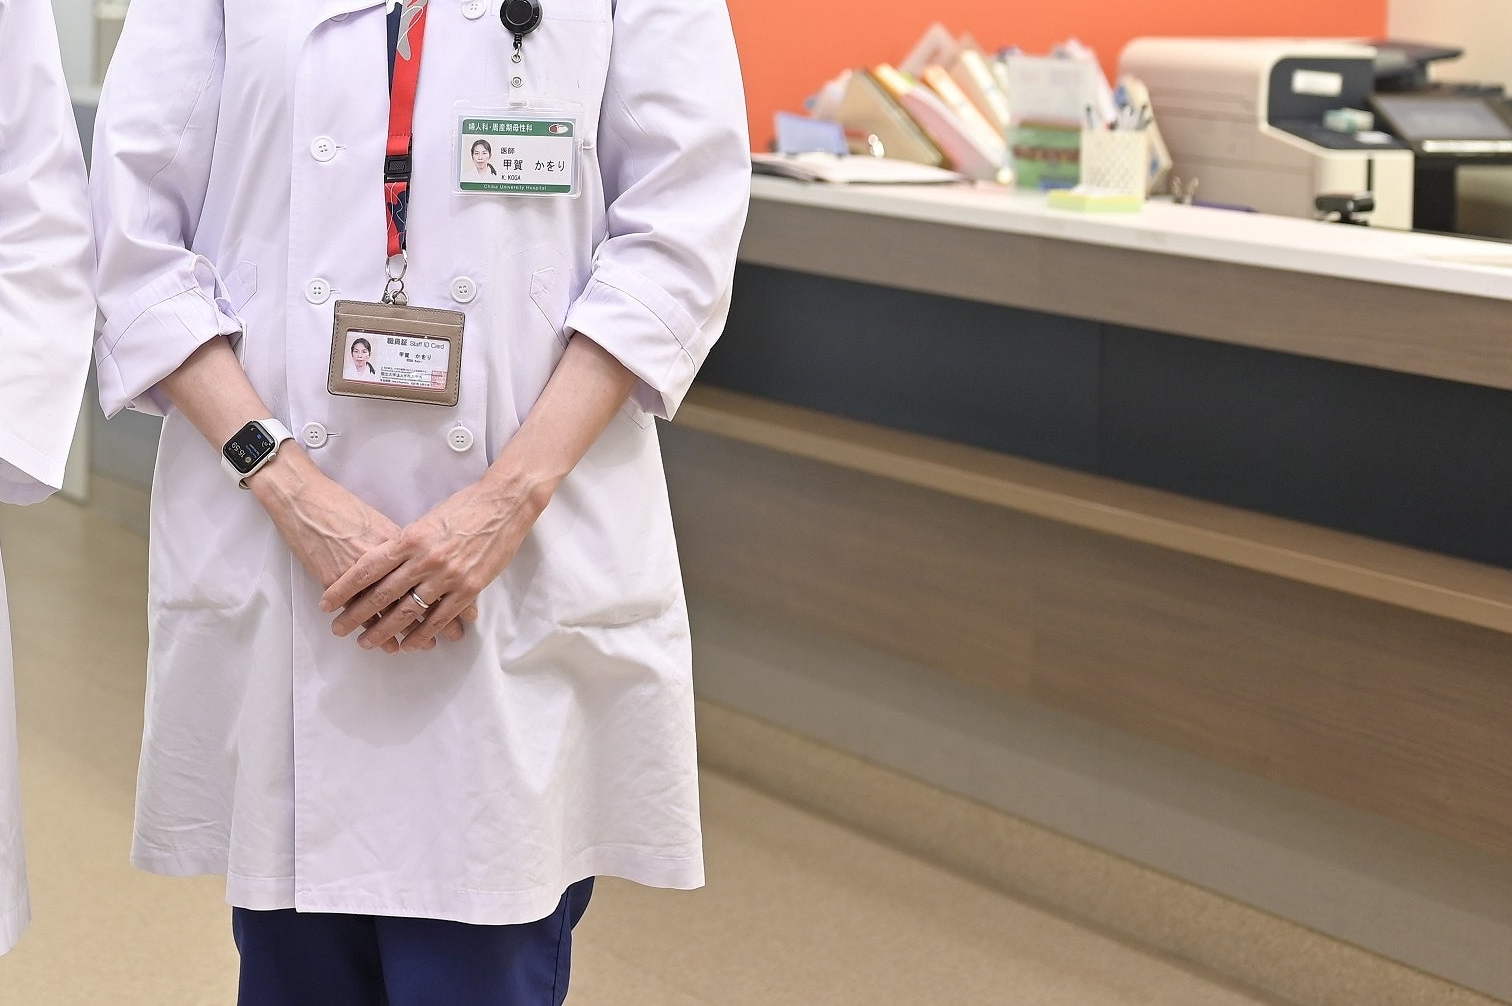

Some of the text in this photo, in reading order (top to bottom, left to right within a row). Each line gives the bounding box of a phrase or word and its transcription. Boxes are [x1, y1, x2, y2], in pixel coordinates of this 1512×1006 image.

[500, 147, 515, 155] 医師
[503, 159, 566, 172] 甲賀 かをり
